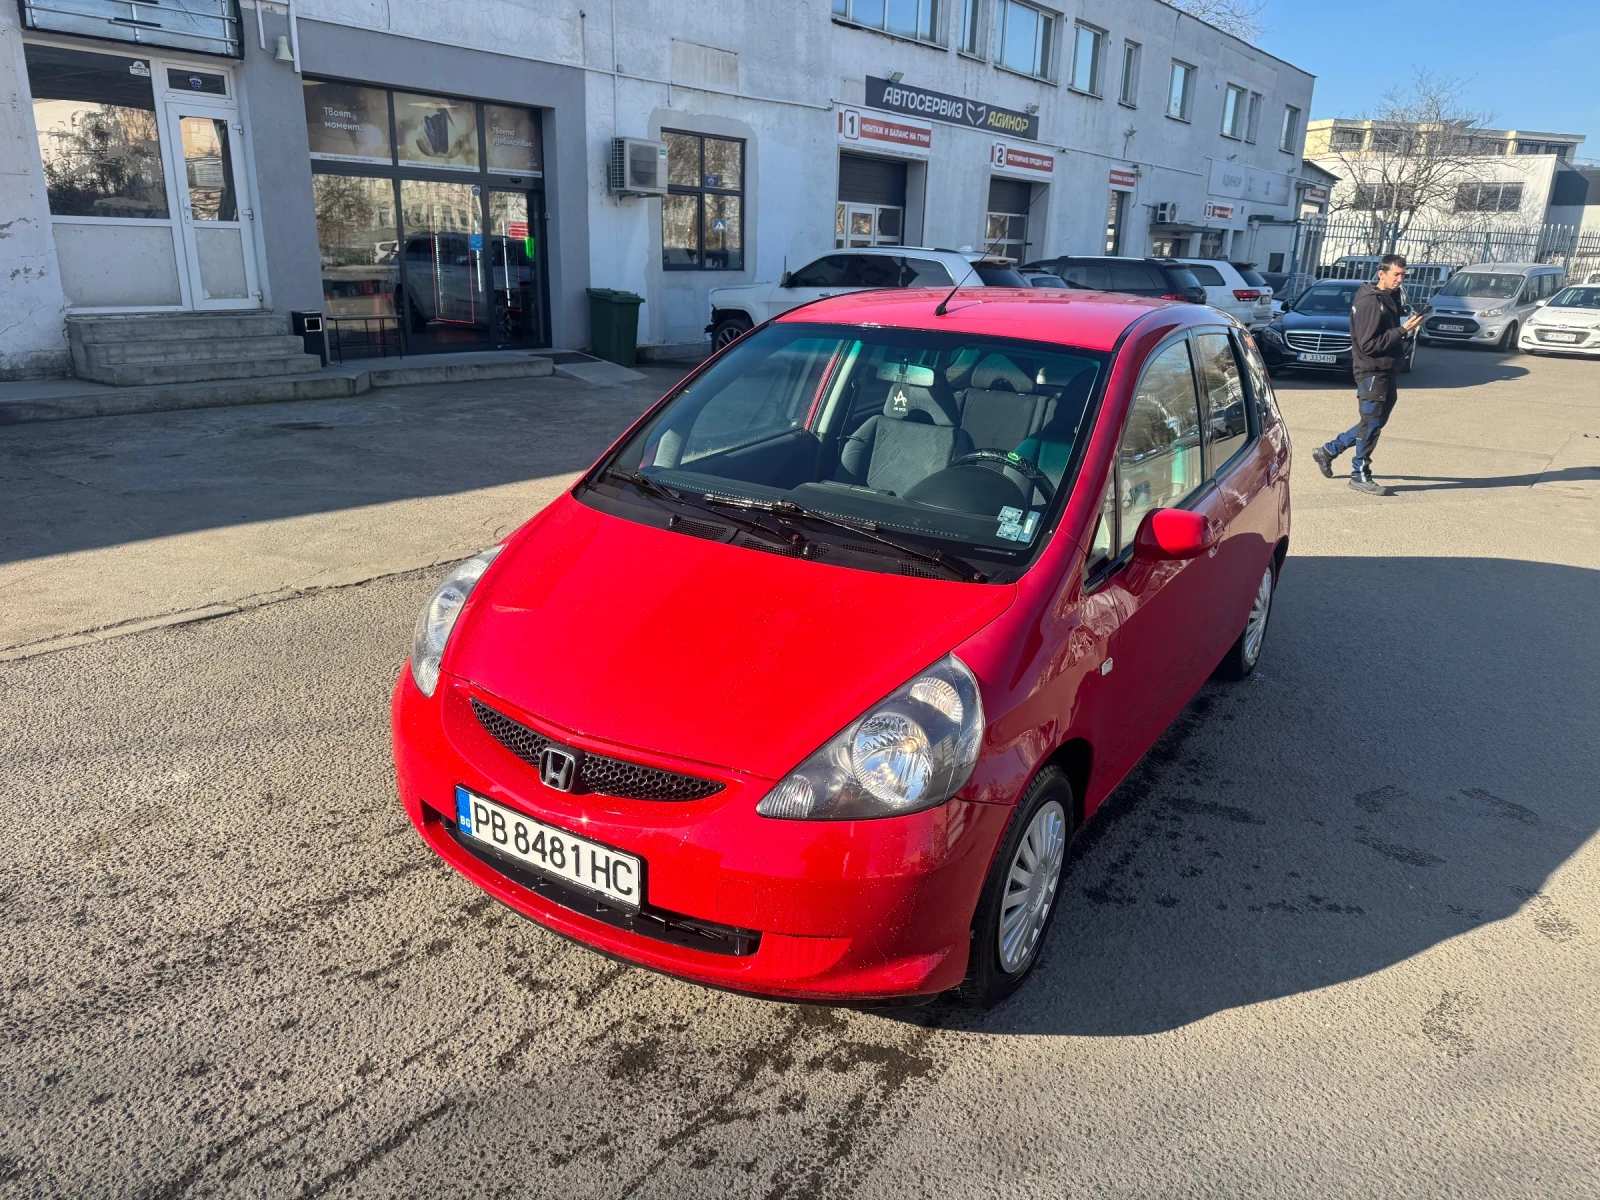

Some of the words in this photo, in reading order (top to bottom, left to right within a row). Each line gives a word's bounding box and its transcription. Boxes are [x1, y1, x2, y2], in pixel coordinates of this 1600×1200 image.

[323, 106, 352, 118] Твоят
[882, 86, 964, 119] АВТОСЕРВИЗ
[987, 110, 1029, 133] АДИНОР
[324, 121, 362, 131] момент.
[492, 126, 515, 136] Твоето
[848, 115, 856, 135] 1
[861, 123, 883, 135] МОНТАЖ
[884, 127, 889, 135] И
[889, 128, 909, 139] БАЛАНС
[909, 132, 917, 140] НА
[916, 133, 930, 142] ГУМИ
[997, 147, 1004, 163] 2
[460, 814, 471, 829] BG
[473, 801, 508, 845] PB
[514, 821, 581, 877] 8481
[590, 850, 632, 896] HC
